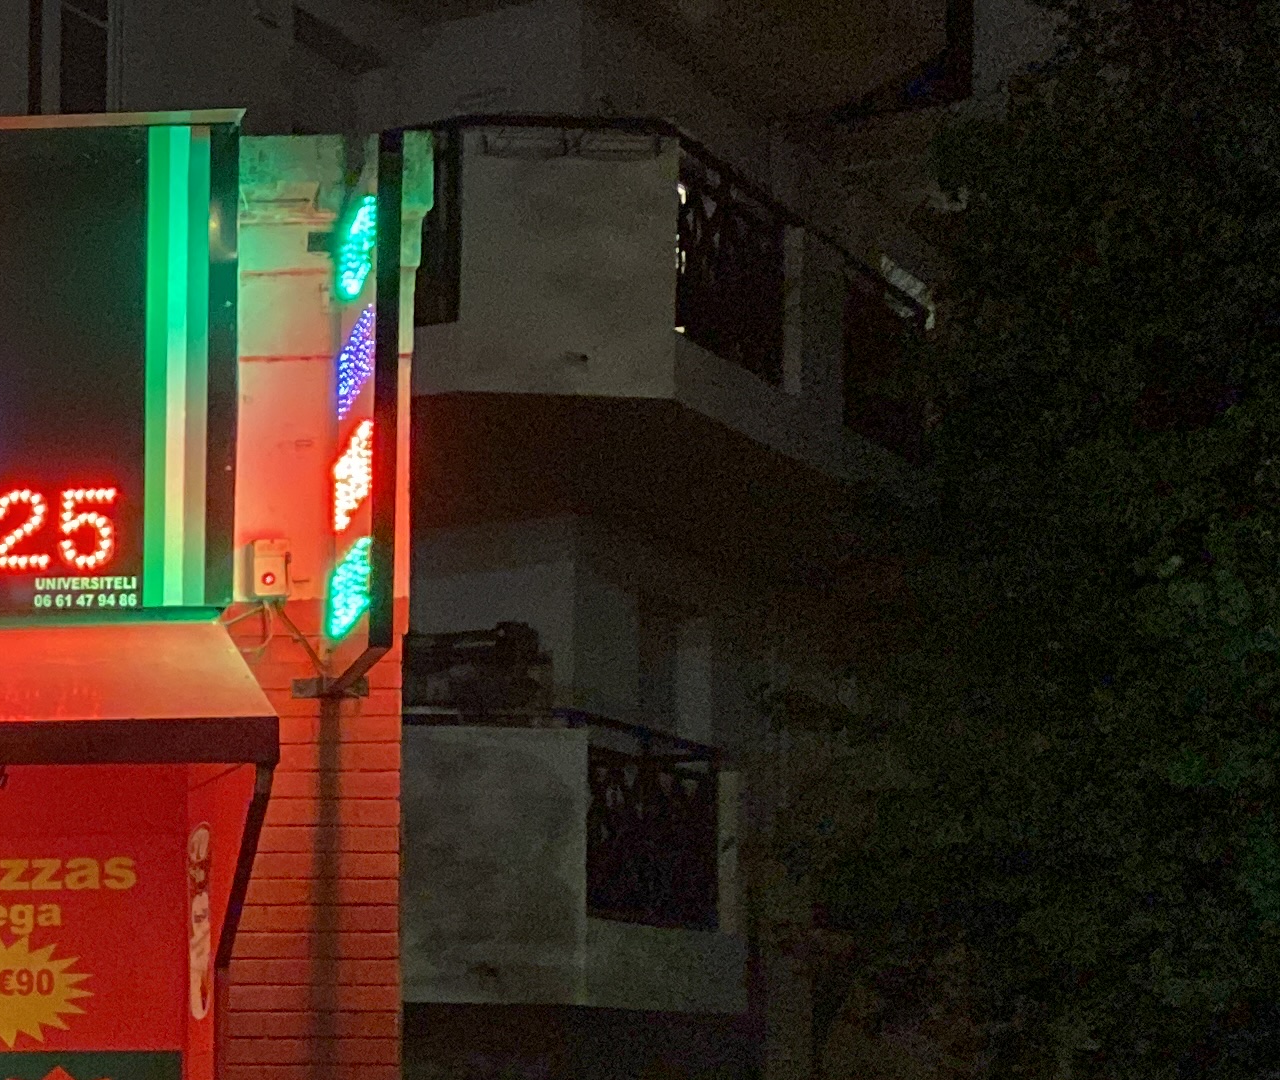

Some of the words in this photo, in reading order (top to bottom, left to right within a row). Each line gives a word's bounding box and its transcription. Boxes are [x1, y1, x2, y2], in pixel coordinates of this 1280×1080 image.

[35, 577, 137, 590] UNIVERSITELI
[34, 594, 52, 608] 06
[55, 594, 71, 608] 61
[75, 594, 94, 608] 47
[97, 593, 116, 607] 94
[119, 593, 137, 607] 86
